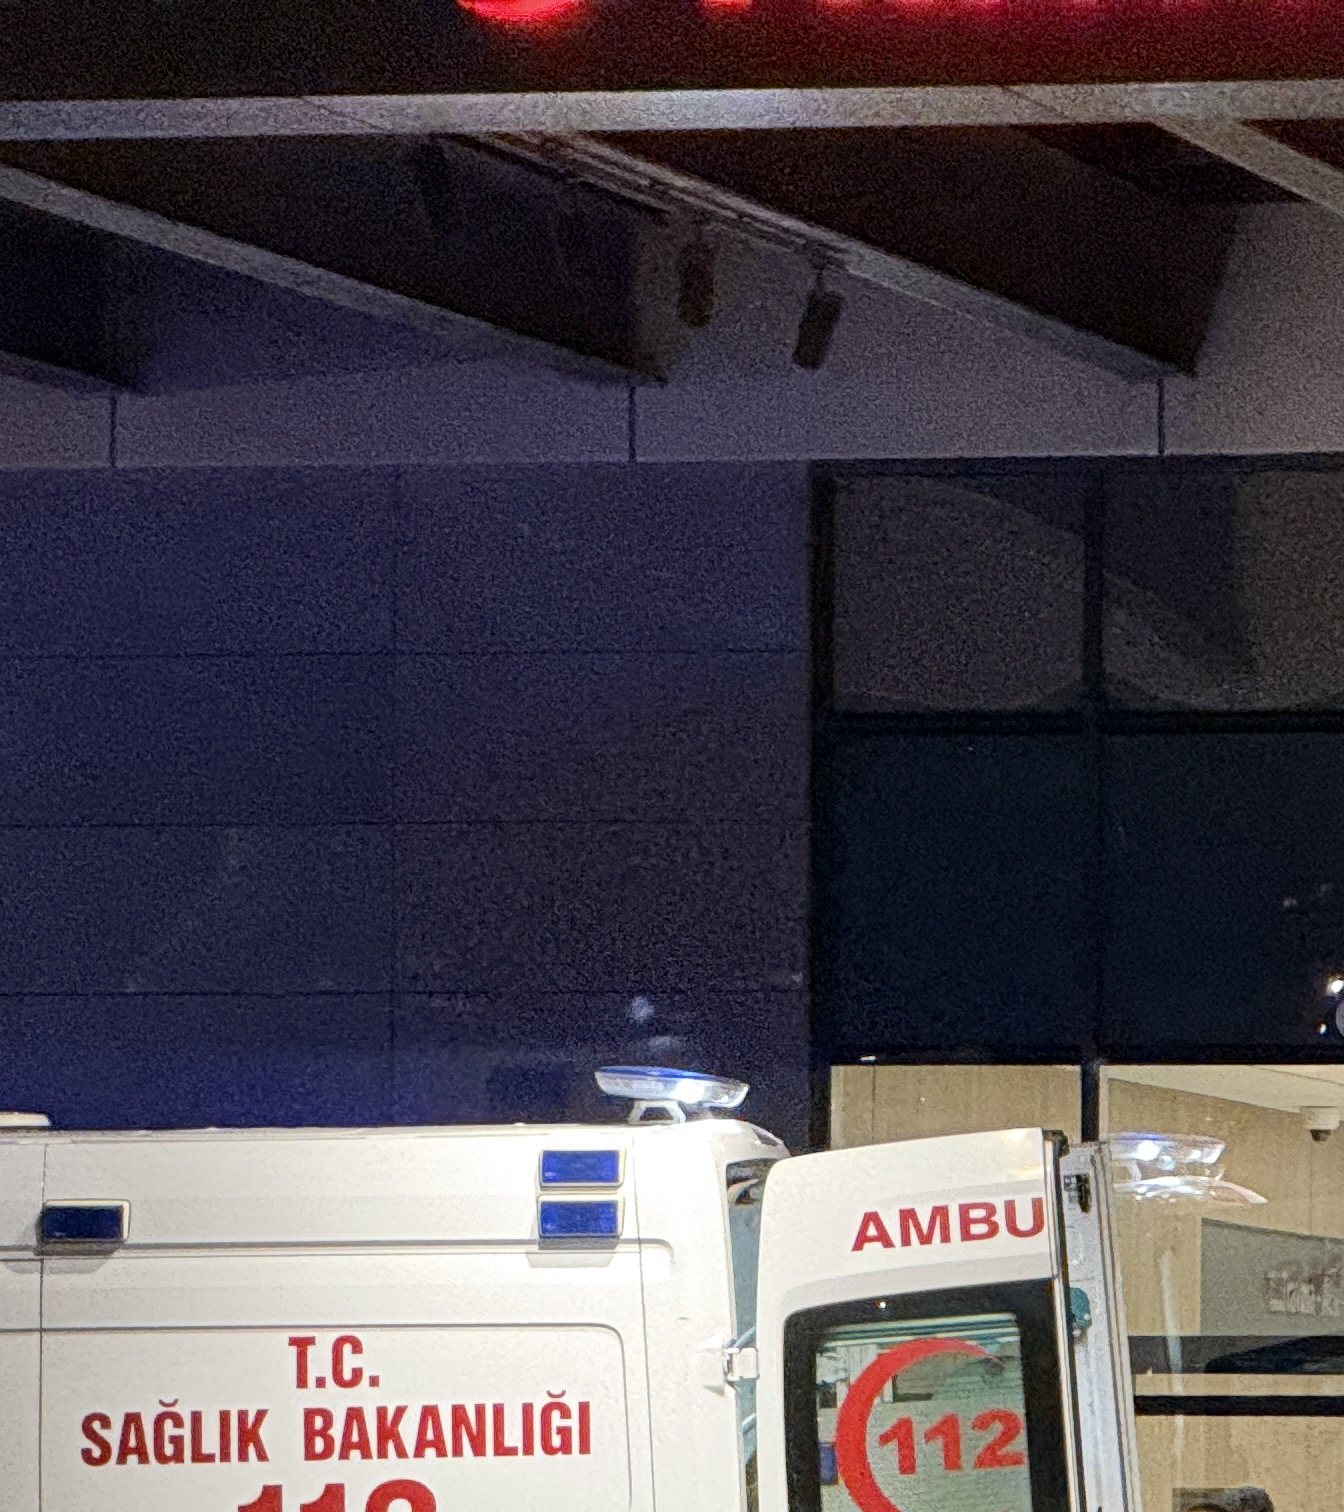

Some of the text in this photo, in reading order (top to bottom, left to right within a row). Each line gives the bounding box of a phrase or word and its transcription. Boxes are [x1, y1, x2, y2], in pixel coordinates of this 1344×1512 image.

[852, 1197, 1045, 1252] AMBU
[288, 1335, 380, 1389] T.C.
[81, 1390, 592, 1466] SAĞLIK BAKANLIĞI
[877, 1409, 1026, 1476] 112
